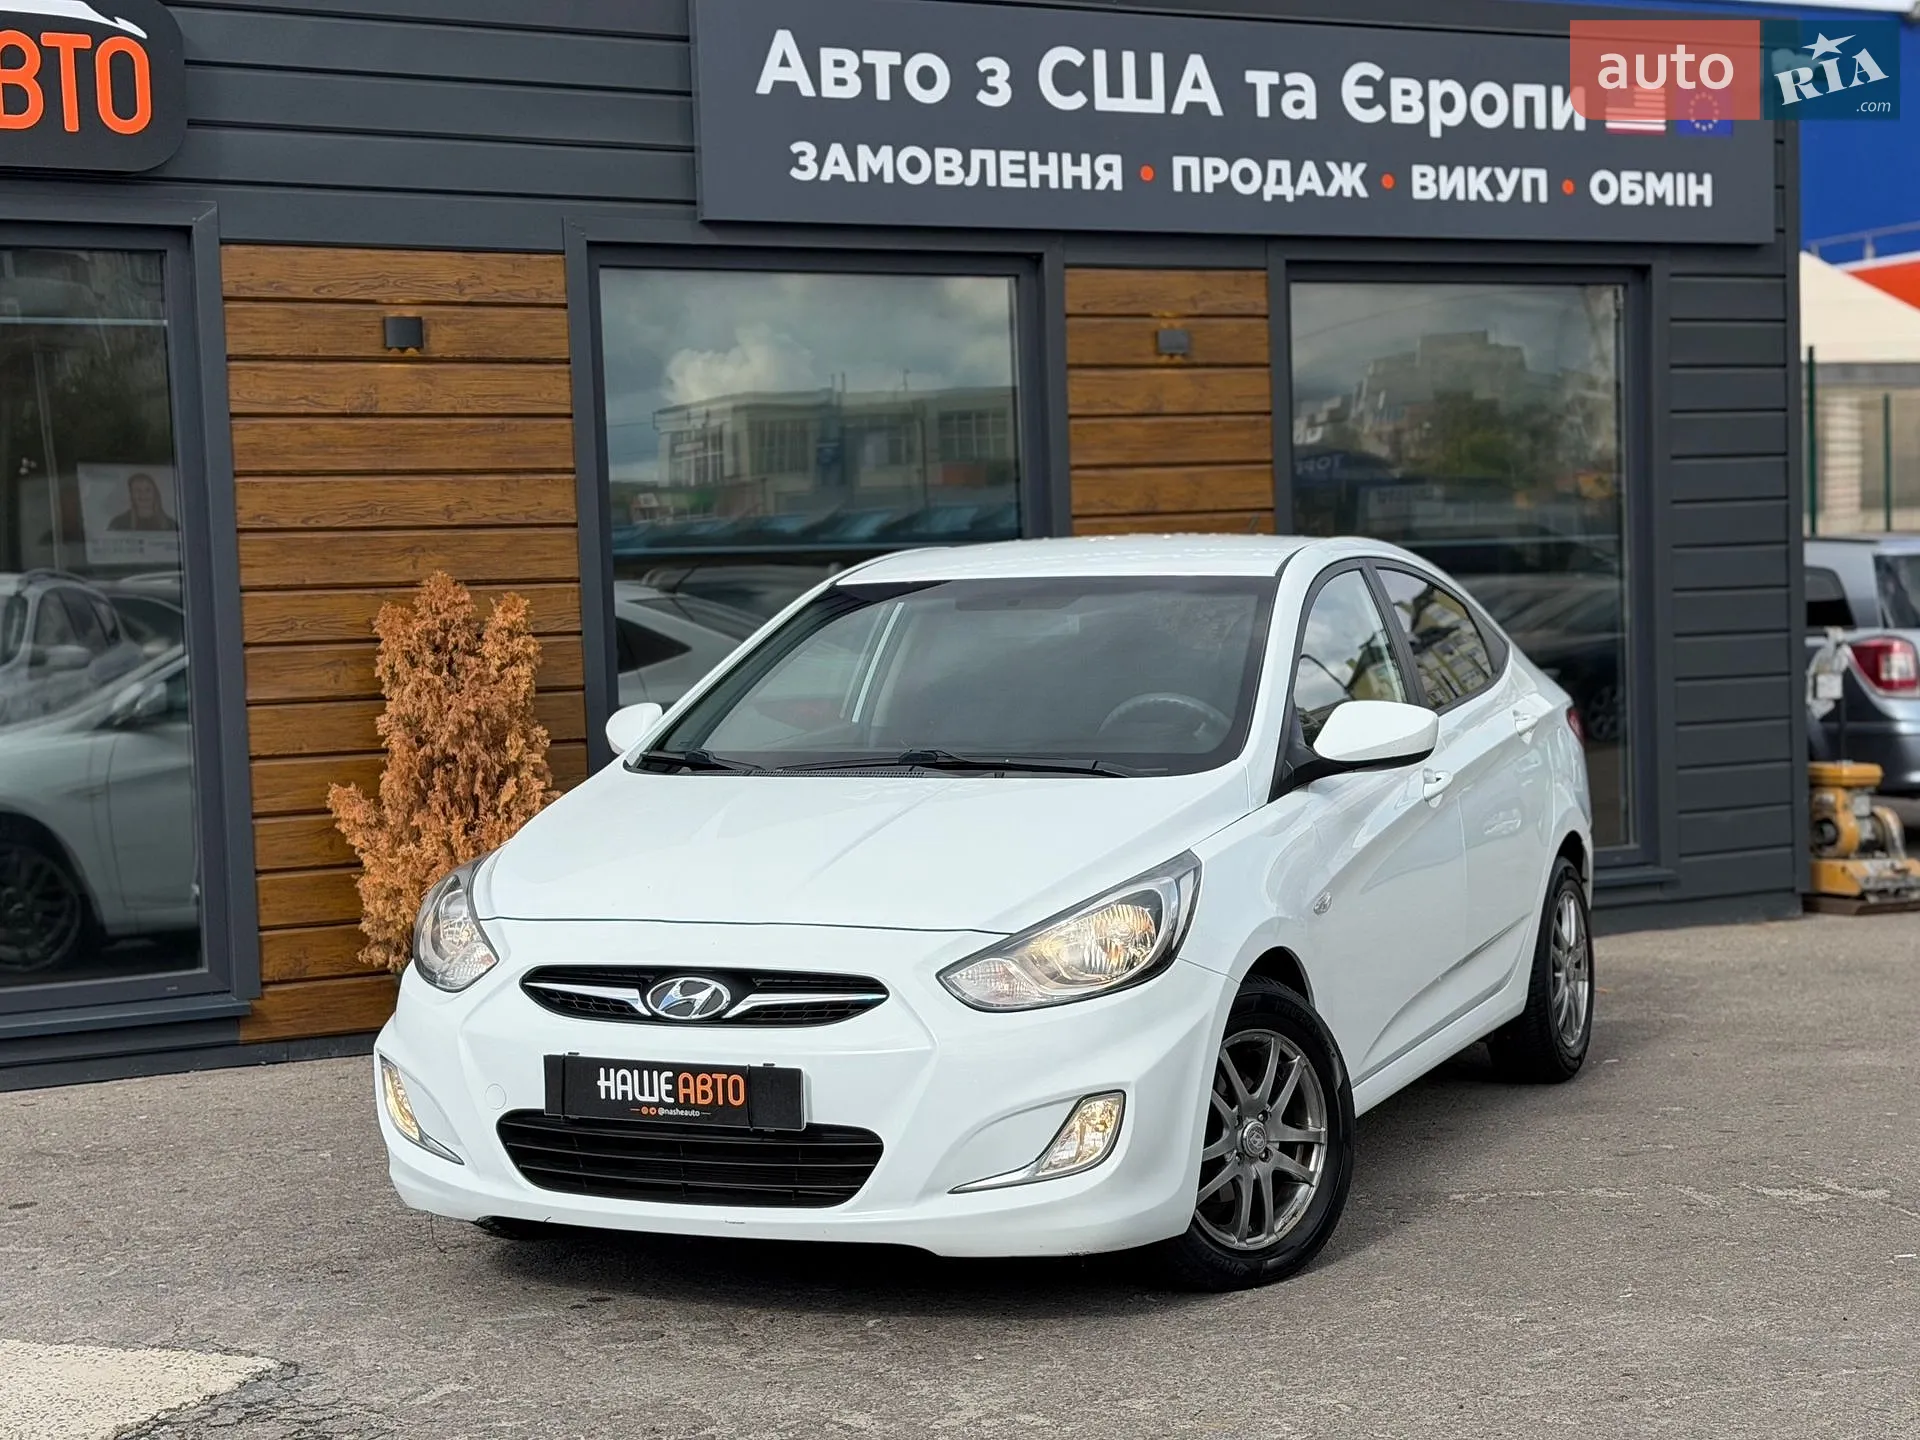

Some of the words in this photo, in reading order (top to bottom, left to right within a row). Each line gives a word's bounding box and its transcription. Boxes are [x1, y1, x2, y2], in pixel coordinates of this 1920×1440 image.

[755, 29, 951, 104] Авто
[975, 57, 1012, 107] з
[1038, 46, 1224, 117] США
[1245, 70, 1317, 120] та
[1341, 62, 1586, 138] Європи
[789, 140, 1123, 191] ЗАМОВЛЕННЯ
[1172, 155, 1369, 203] ПРОДАЖ
[1411, 164, 1548, 203] ВИКУП
[1589, 170, 1713, 207] ОБМІН
[678, 1072, 745, 1106] АВТО
